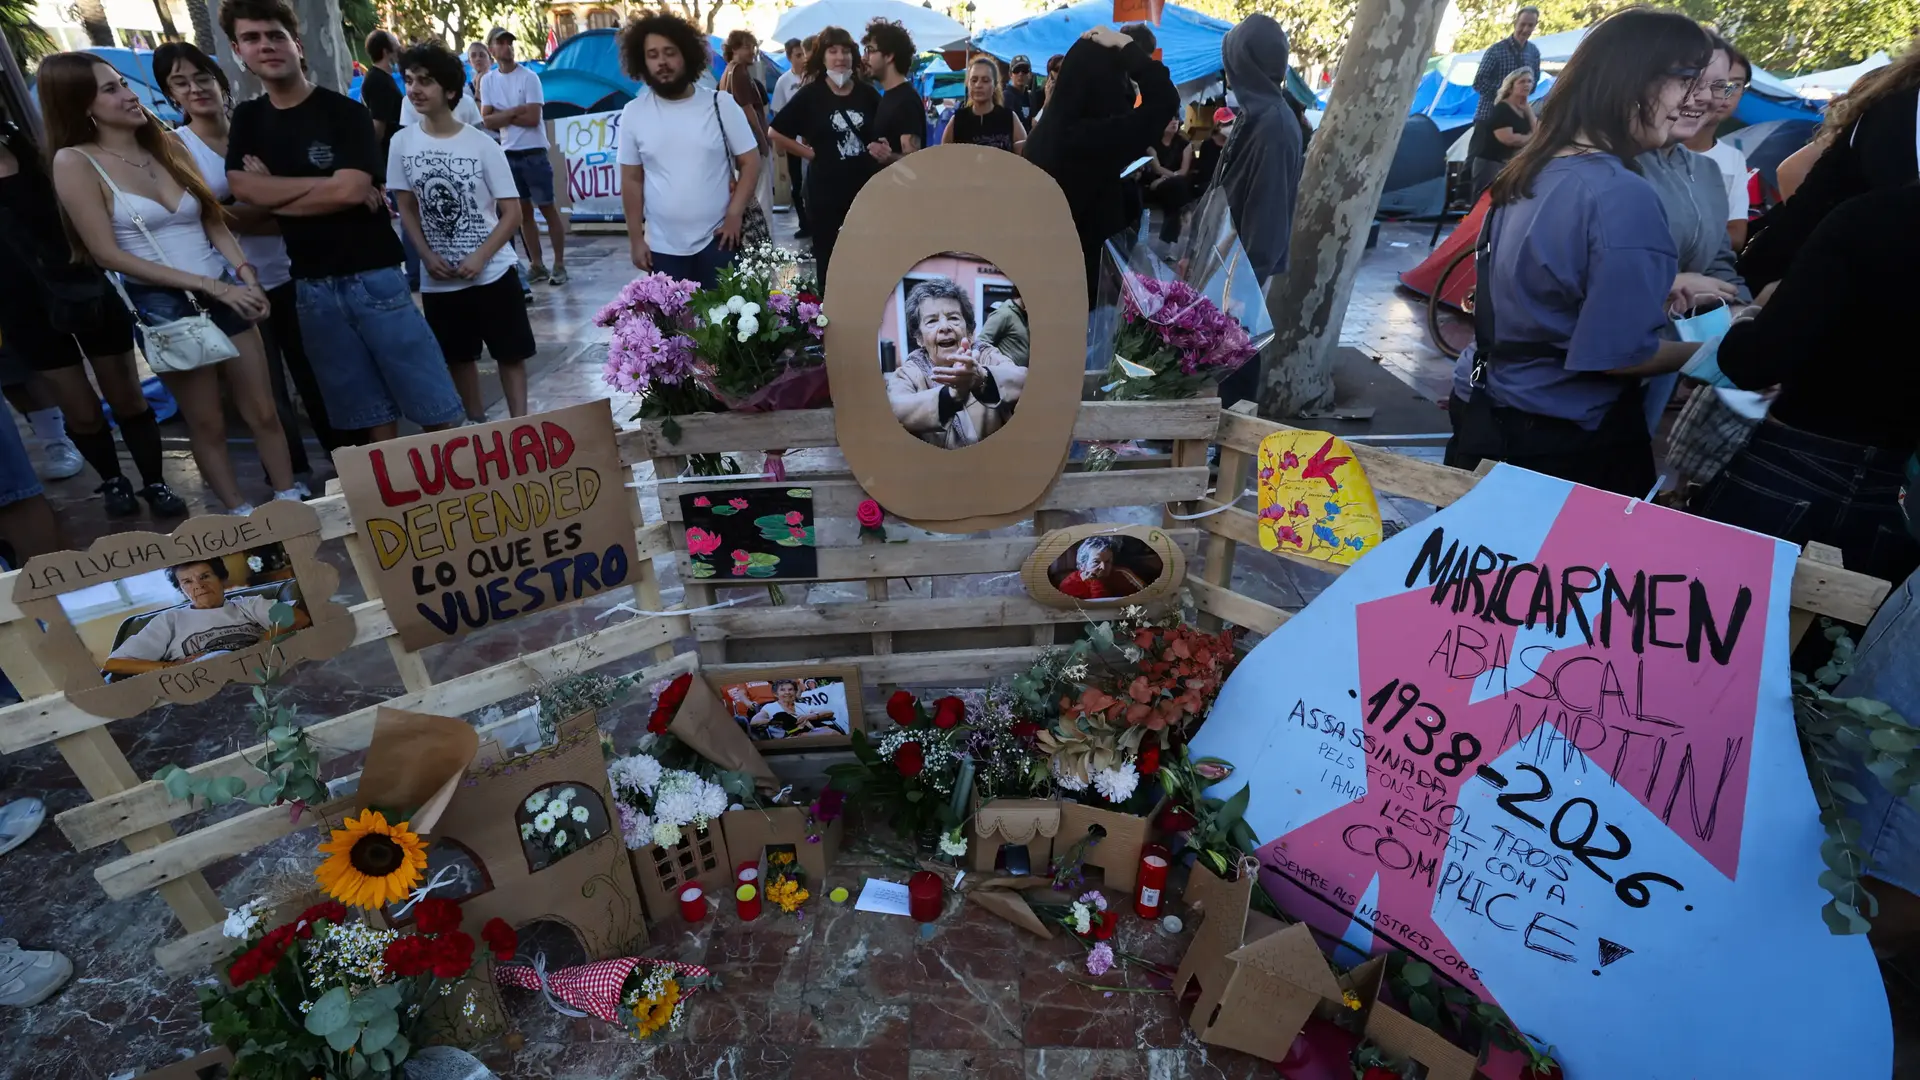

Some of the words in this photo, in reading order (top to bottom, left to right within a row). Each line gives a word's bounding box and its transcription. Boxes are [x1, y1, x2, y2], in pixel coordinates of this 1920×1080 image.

[368, 421, 575, 507] LUCHAD
[366, 467, 601, 570] DEFENDED
[412, 561, 457, 595] LO
[467, 537, 536, 578] QUE
[543, 522, 582, 558] ES
[29, 567, 65, 590] LA
[74, 543, 165, 578] LUCHA
[416, 543, 628, 635] VUESTRO
[1405, 526, 1752, 666] MARICARMEN
[159, 667, 215, 695] POR
[1428, 625, 1685, 729] ABASCAL
[1288, 698, 1448, 796] ASSASSINADA
[1318, 742, 1355, 769] PELS
[1366, 765, 1416, 801] FONS
[1331, 775, 1367, 803] AMB
[1546, 884, 1566, 905] A
[1273, 846, 1329, 890] SEMPRE
[1333, 886, 1357, 906] ALS
[1359, 904, 1433, 951] NOSTRES
